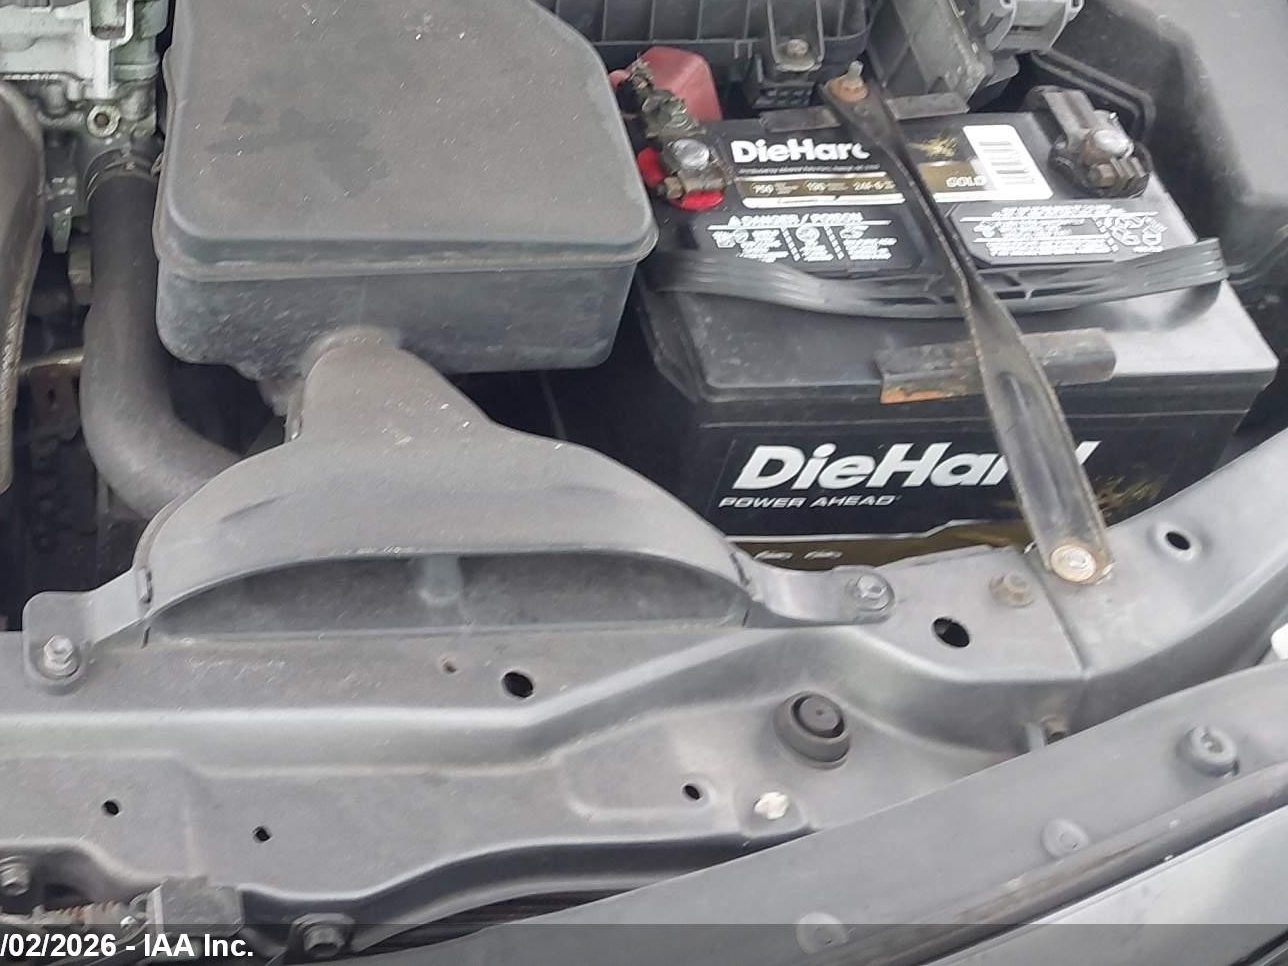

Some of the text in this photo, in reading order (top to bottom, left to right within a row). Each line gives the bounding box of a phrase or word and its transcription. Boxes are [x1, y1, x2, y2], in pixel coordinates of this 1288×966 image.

[946, 175, 987, 187] GOLD
[718, 495, 897, 509] POWER AHEAD
